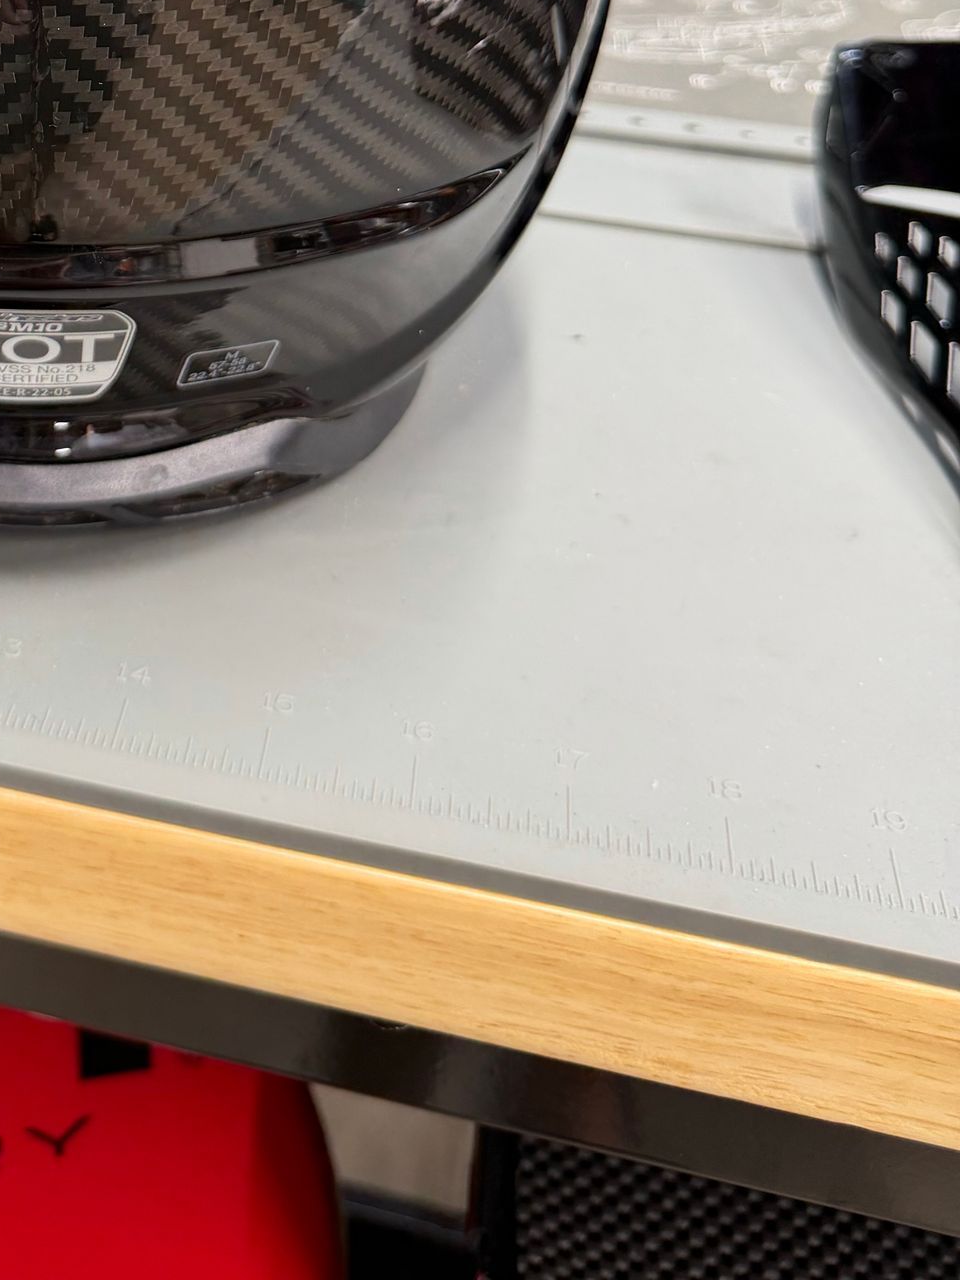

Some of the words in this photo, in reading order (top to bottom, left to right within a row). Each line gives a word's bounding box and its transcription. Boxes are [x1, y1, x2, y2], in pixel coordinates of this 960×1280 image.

[37, 363, 96, 374] No.218
[115, 660, 152, 688] 14
[708, 776, 743, 800] 18
[871, 807, 907, 831] 19
